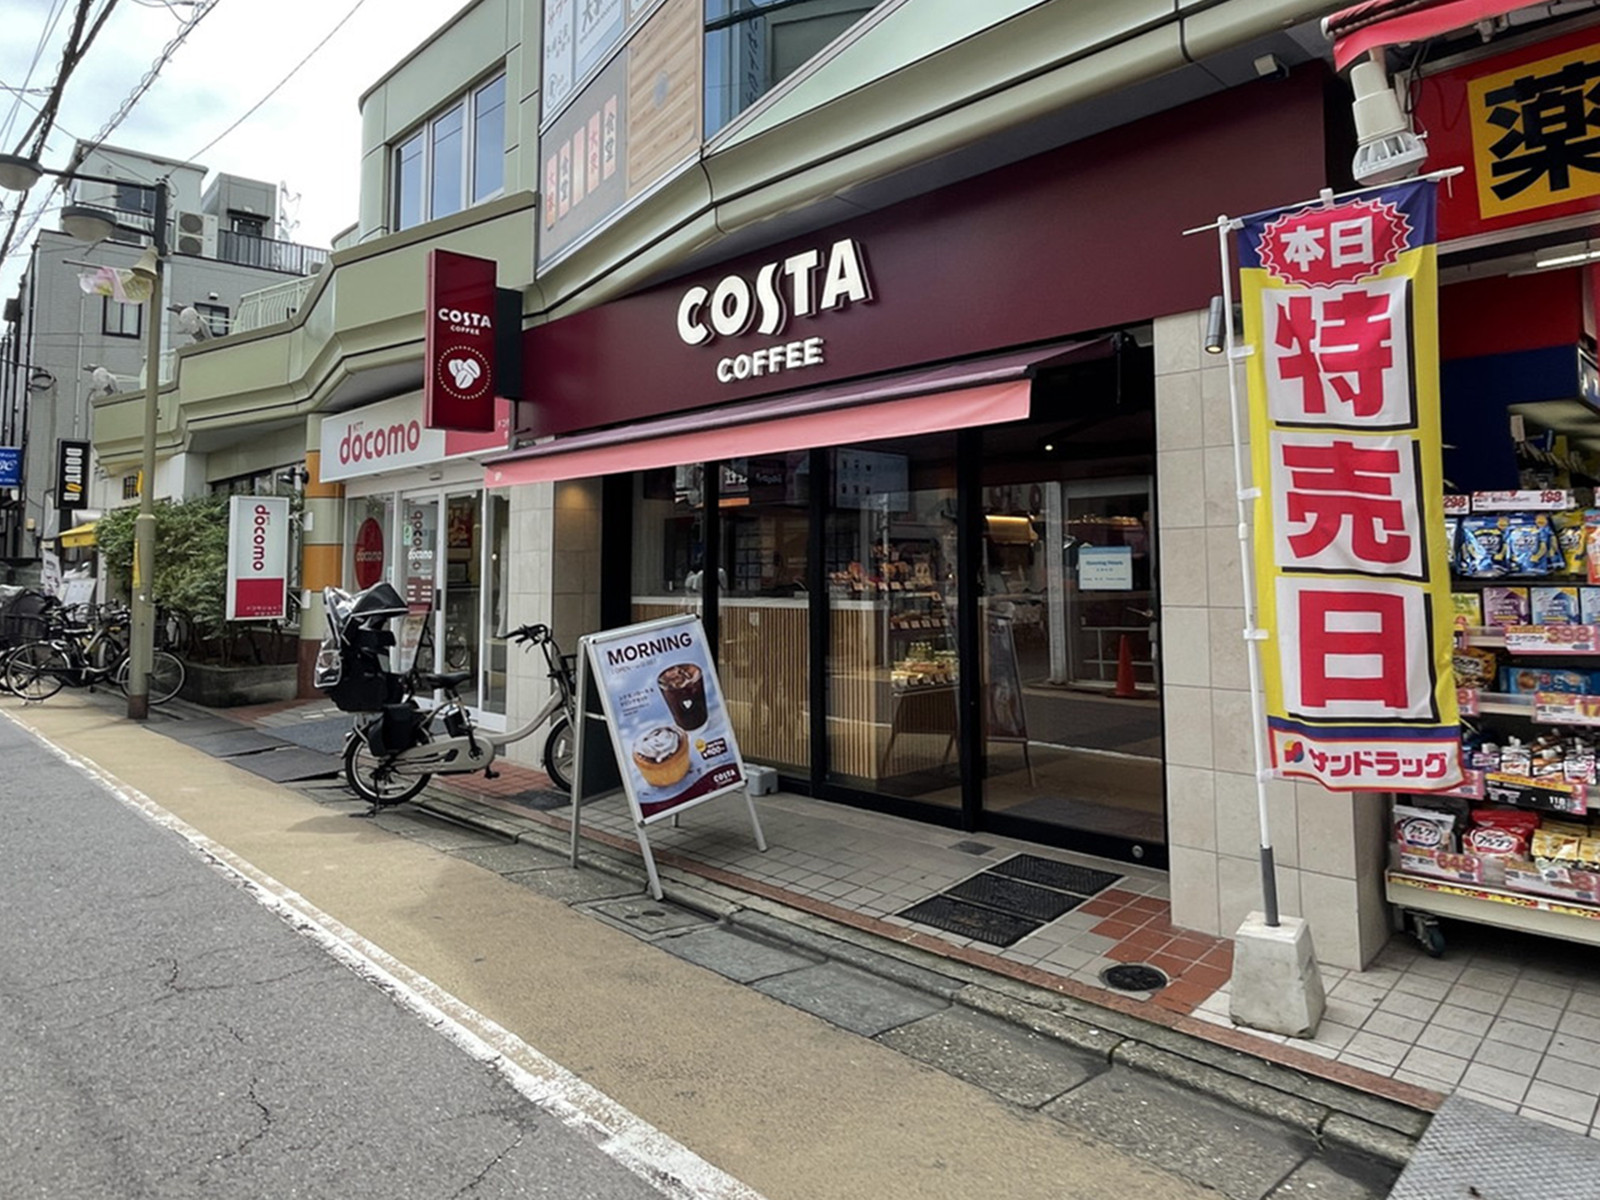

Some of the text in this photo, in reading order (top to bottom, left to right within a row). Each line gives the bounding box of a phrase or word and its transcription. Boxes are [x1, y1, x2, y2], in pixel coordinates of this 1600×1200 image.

[1484, 60, 1600, 201] 薬
[1279, 215, 1375, 273] 本日
[677, 238, 870, 345] COSTA
[437, 307, 492, 328] COSTA
[450, 324, 480, 336] COFFEE
[716, 336, 824, 383] COFFEE
[339, 419, 421, 465] docomo
[1274, 289, 1412, 710] 特売日
[252, 504, 271, 571] docomo
[607, 632, 693, 666] MORNING
[1308, 747, 1448, 781] サンドラッグ
